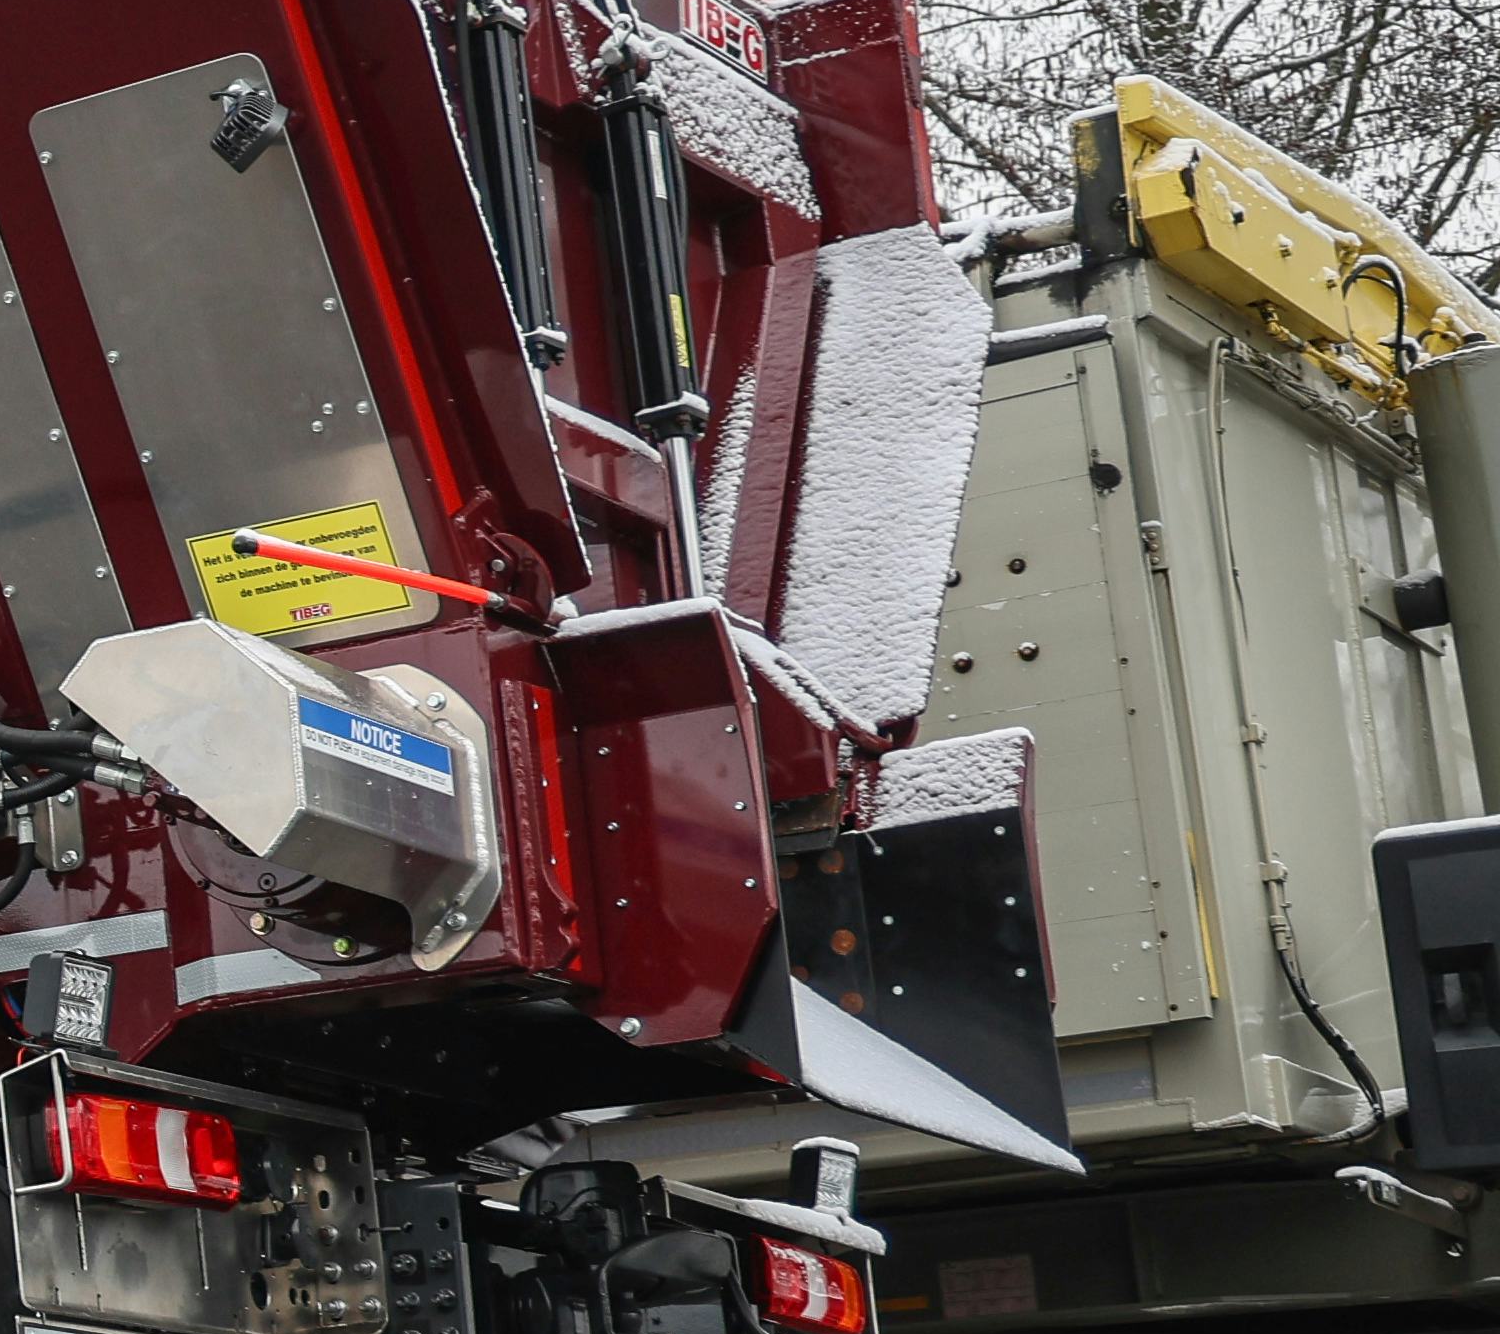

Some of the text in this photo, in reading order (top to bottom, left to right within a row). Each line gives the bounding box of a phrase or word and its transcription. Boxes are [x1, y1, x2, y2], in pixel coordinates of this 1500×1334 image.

[308, 523, 378, 548] onbevoegden
[203, 555, 221, 567] Het
[224, 553, 233, 564] is
[357, 544, 378, 556] van
[215, 572, 238, 584] zich
[239, 566, 274, 580] binnen
[275, 562, 289, 572] de
[240, 587, 253, 598] de
[255, 579, 299, 596] machine
[300, 576, 312, 587] te
[290, 604, 332, 623] TIBEG
[350, 718, 403, 756] NOTICE
